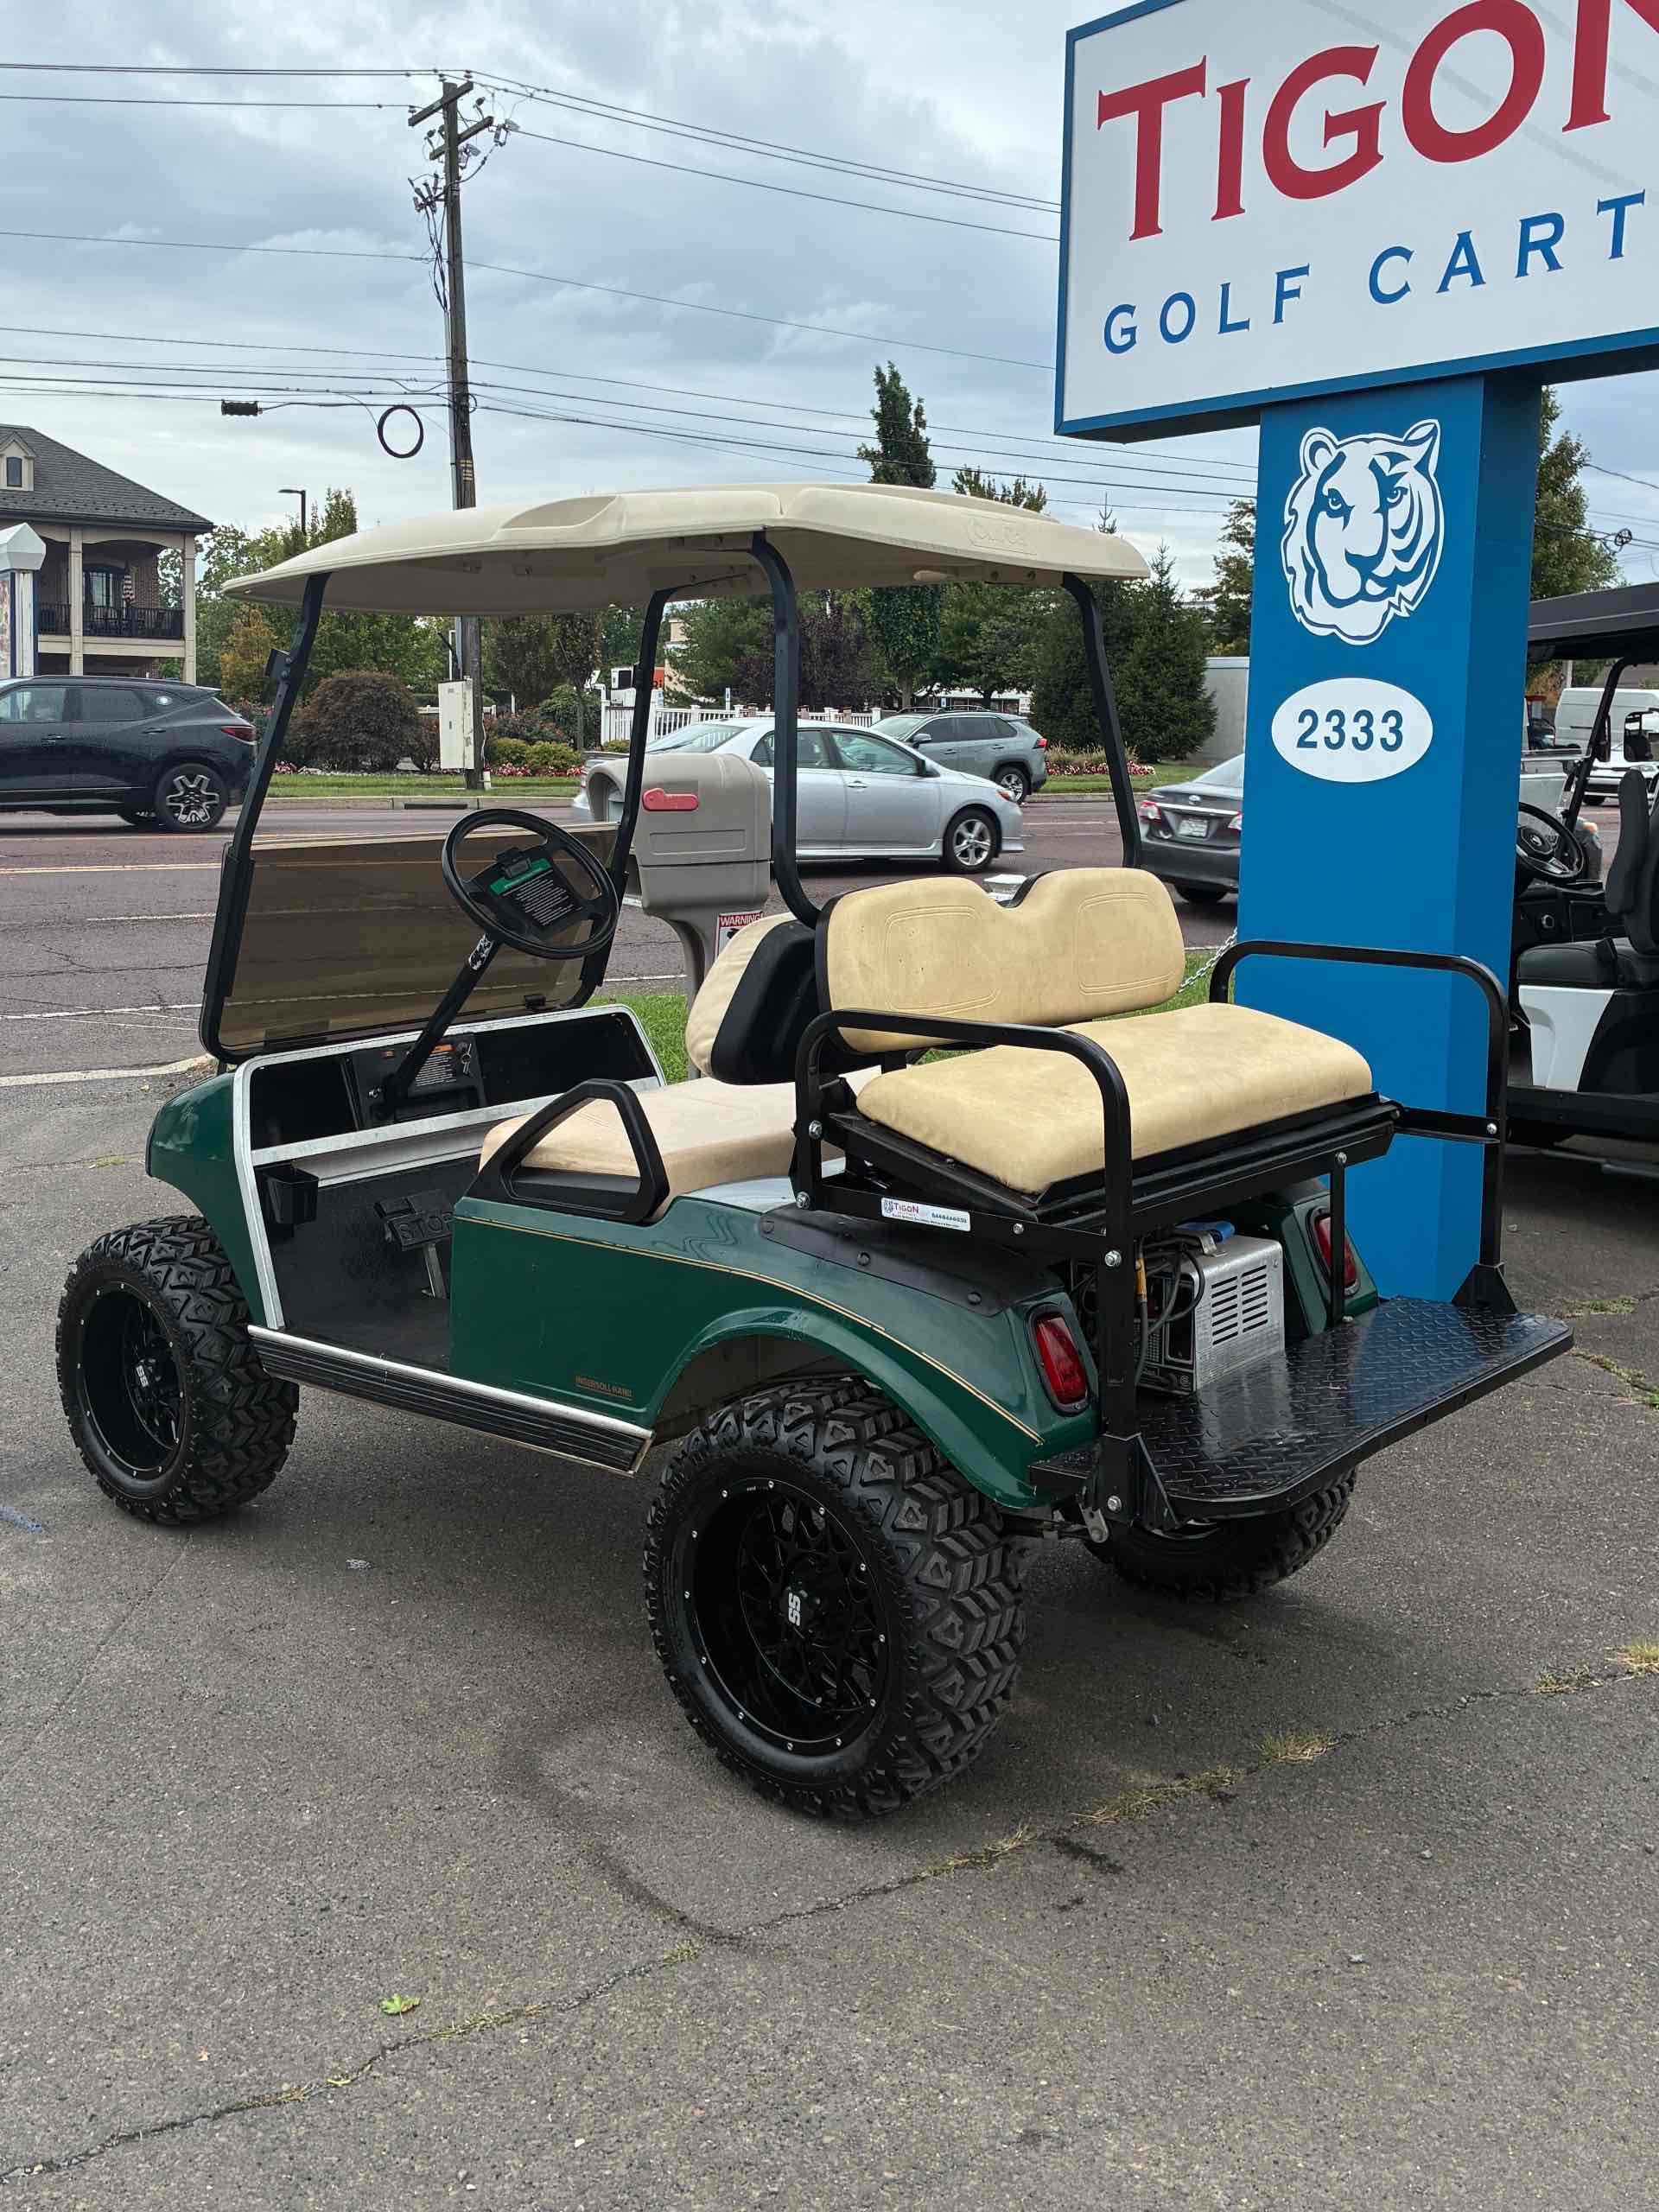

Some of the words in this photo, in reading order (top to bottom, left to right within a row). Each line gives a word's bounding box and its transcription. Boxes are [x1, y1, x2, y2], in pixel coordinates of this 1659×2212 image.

[1103, 263, 1311, 354] GOLF
[1368, 188, 1646, 305] CART
[1296, 709, 1404, 753] 2333
[720, 913, 760, 927] WARNING
[892, 1202, 919, 1214] TIGON
[135, 1365, 148, 1387] SS
[788, 1592, 801, 1626] SS
